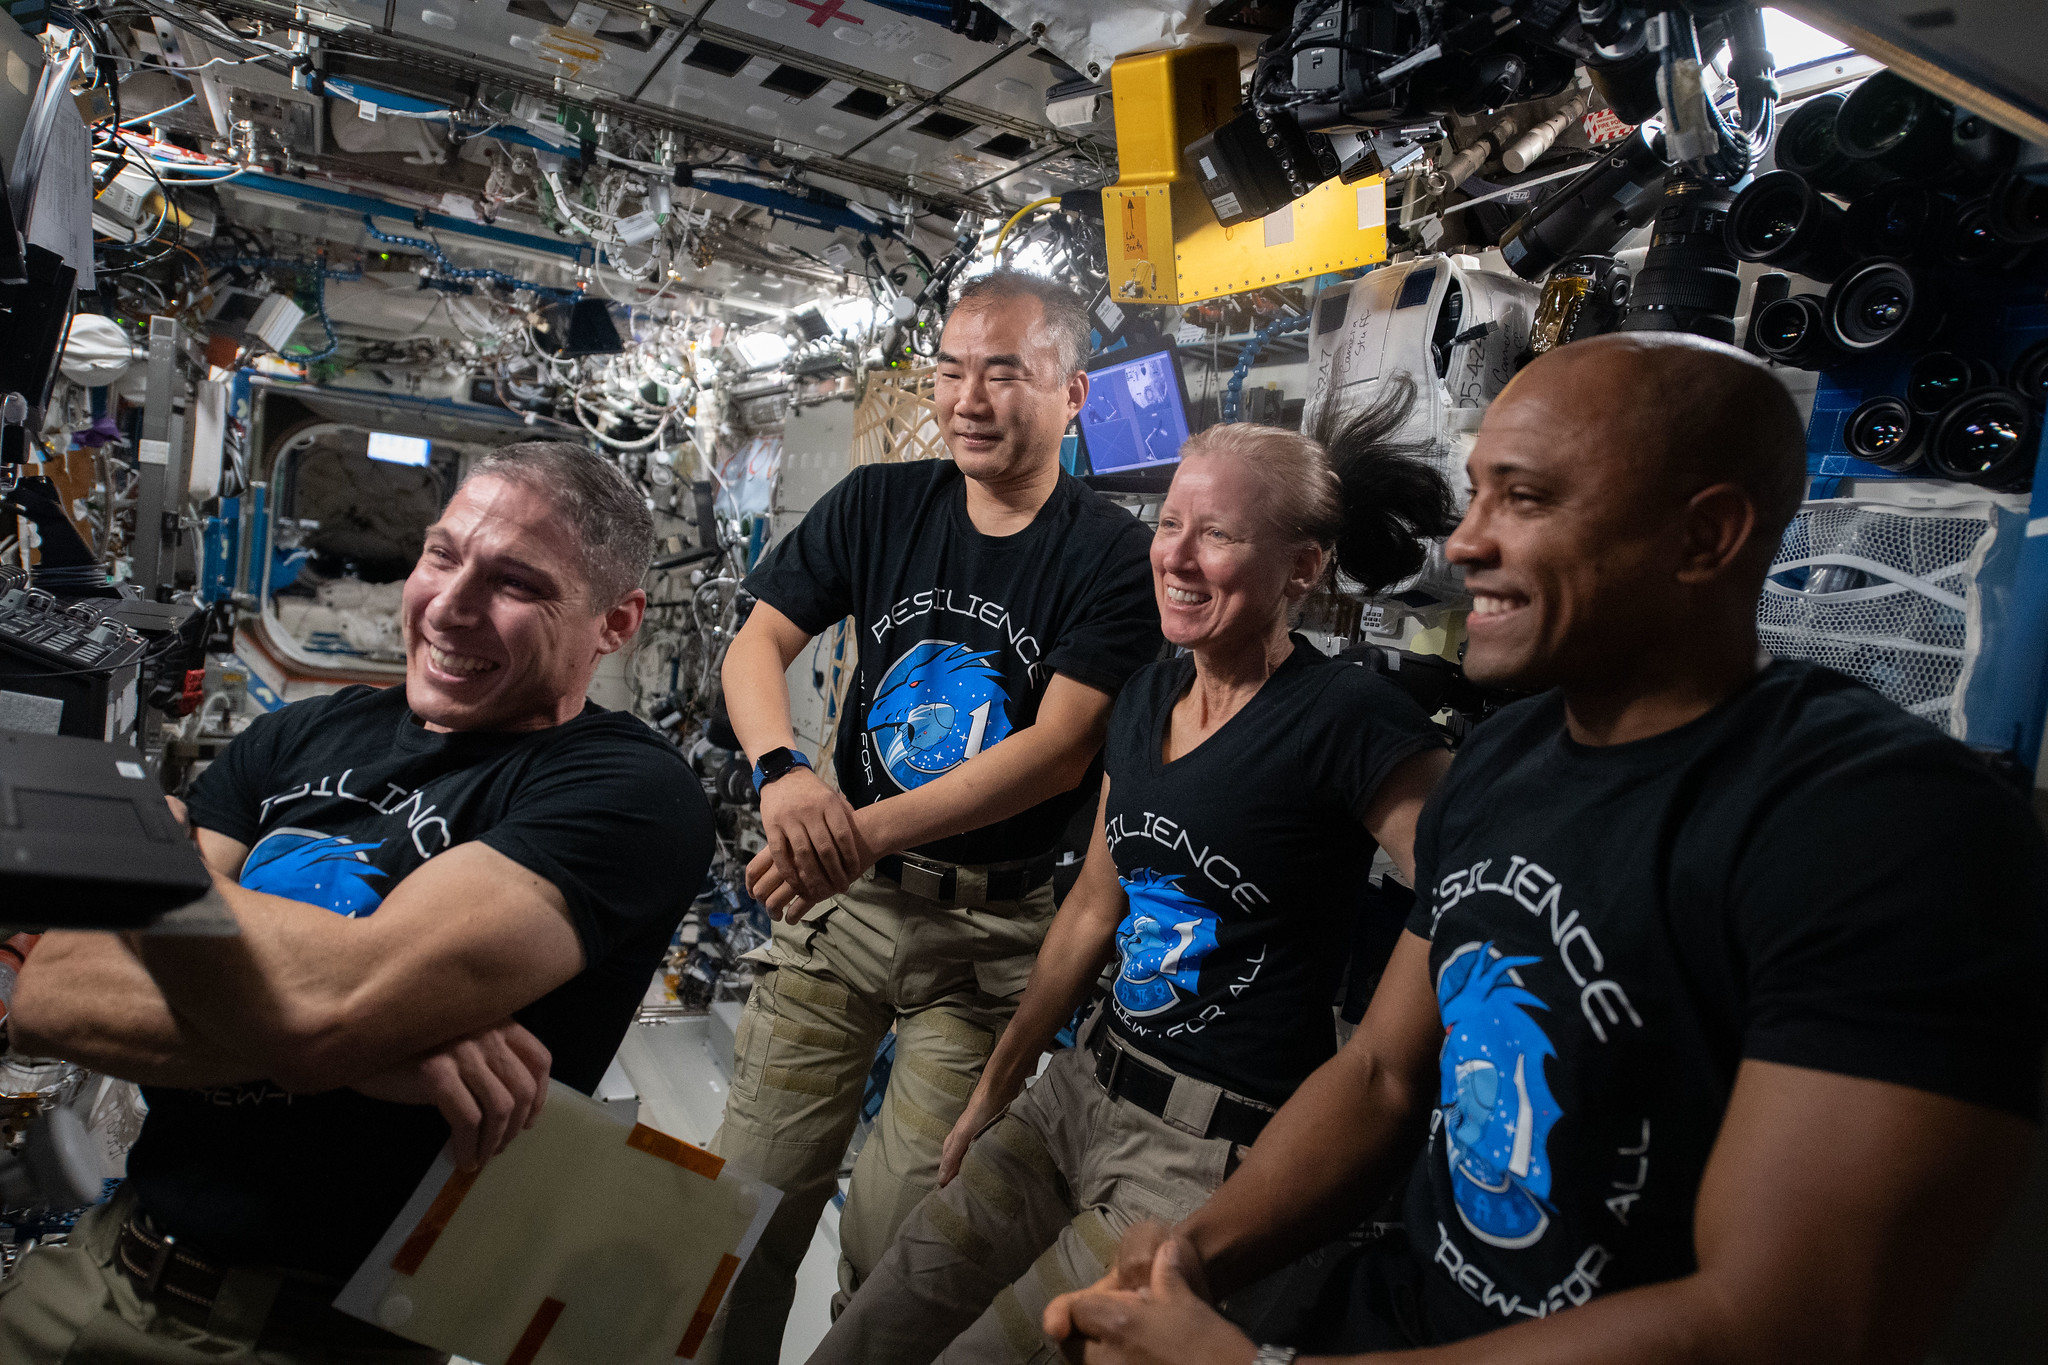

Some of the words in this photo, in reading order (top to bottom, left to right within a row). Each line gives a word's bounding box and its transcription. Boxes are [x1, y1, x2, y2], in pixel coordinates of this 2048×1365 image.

[1342, 320, 1358, 373] Camera
[871, 587, 1047, 690] RESILIENCE
[1166, 1004, 1226, 1038] FOR
[1230, 943, 1267, 999] ALL
[1605, 1117, 1651, 1227] ALL
